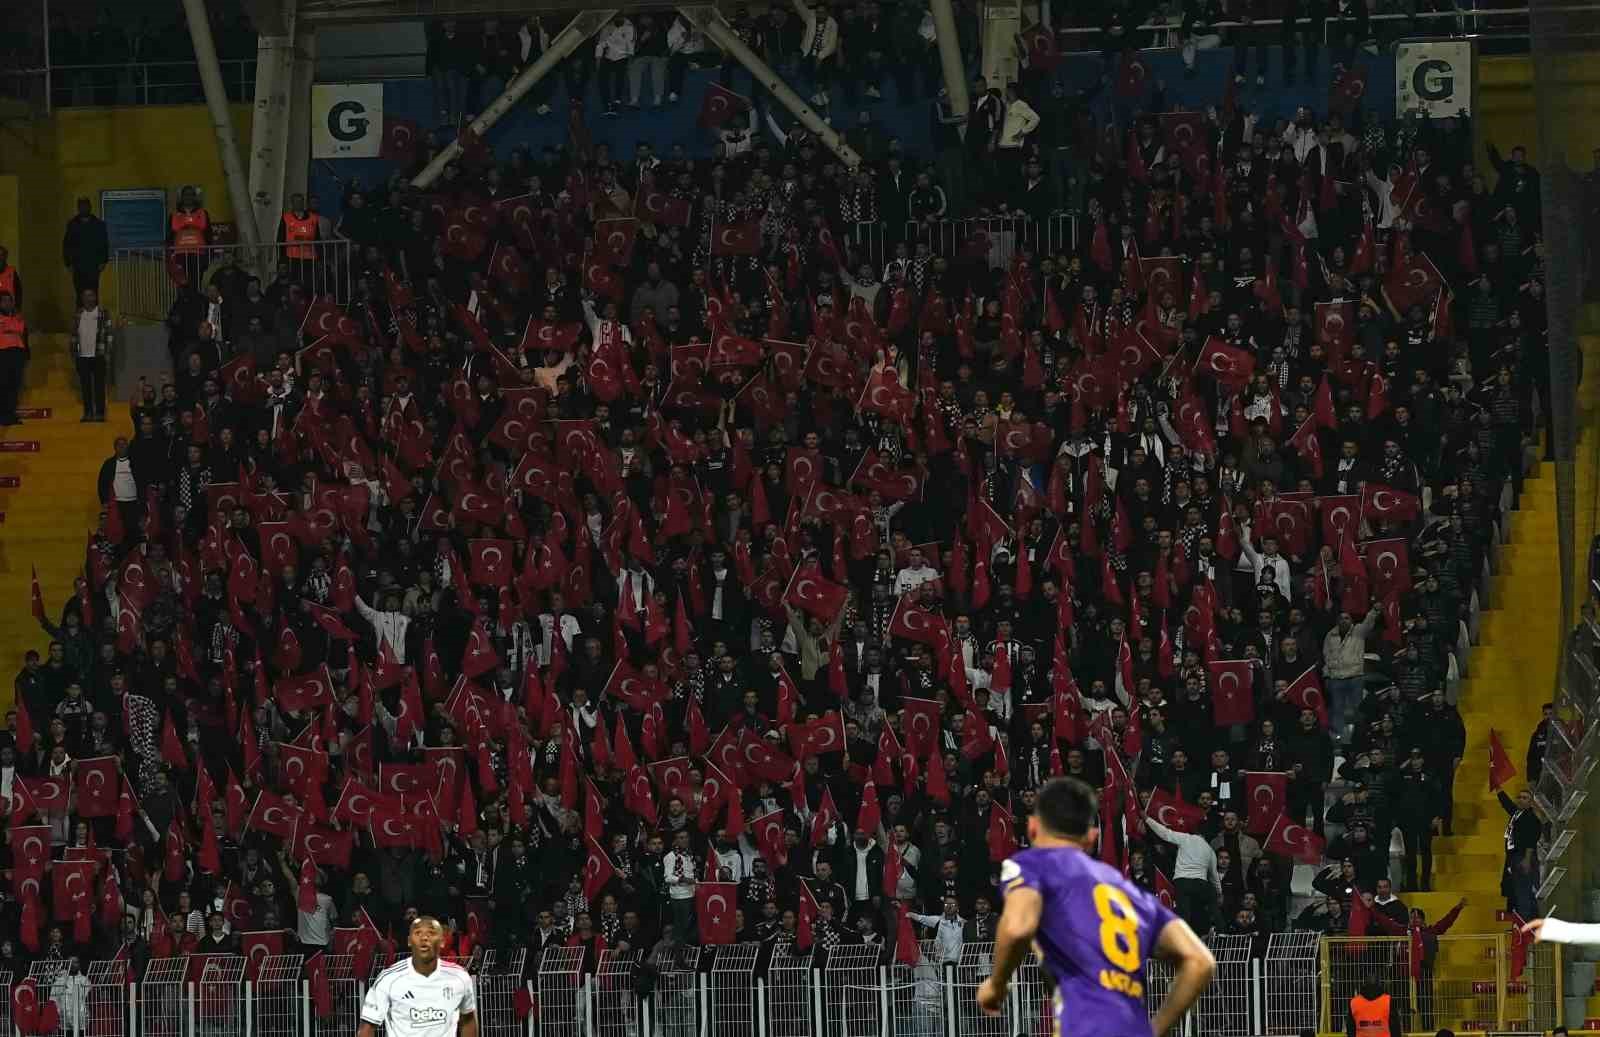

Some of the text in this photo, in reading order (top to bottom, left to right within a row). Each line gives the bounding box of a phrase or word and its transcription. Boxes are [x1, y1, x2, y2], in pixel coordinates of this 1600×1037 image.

[1413, 60, 1454, 101] G
[328, 101, 368, 141] G
[1093, 883, 1141, 973] 8
[410, 1007, 447, 1022] beko
